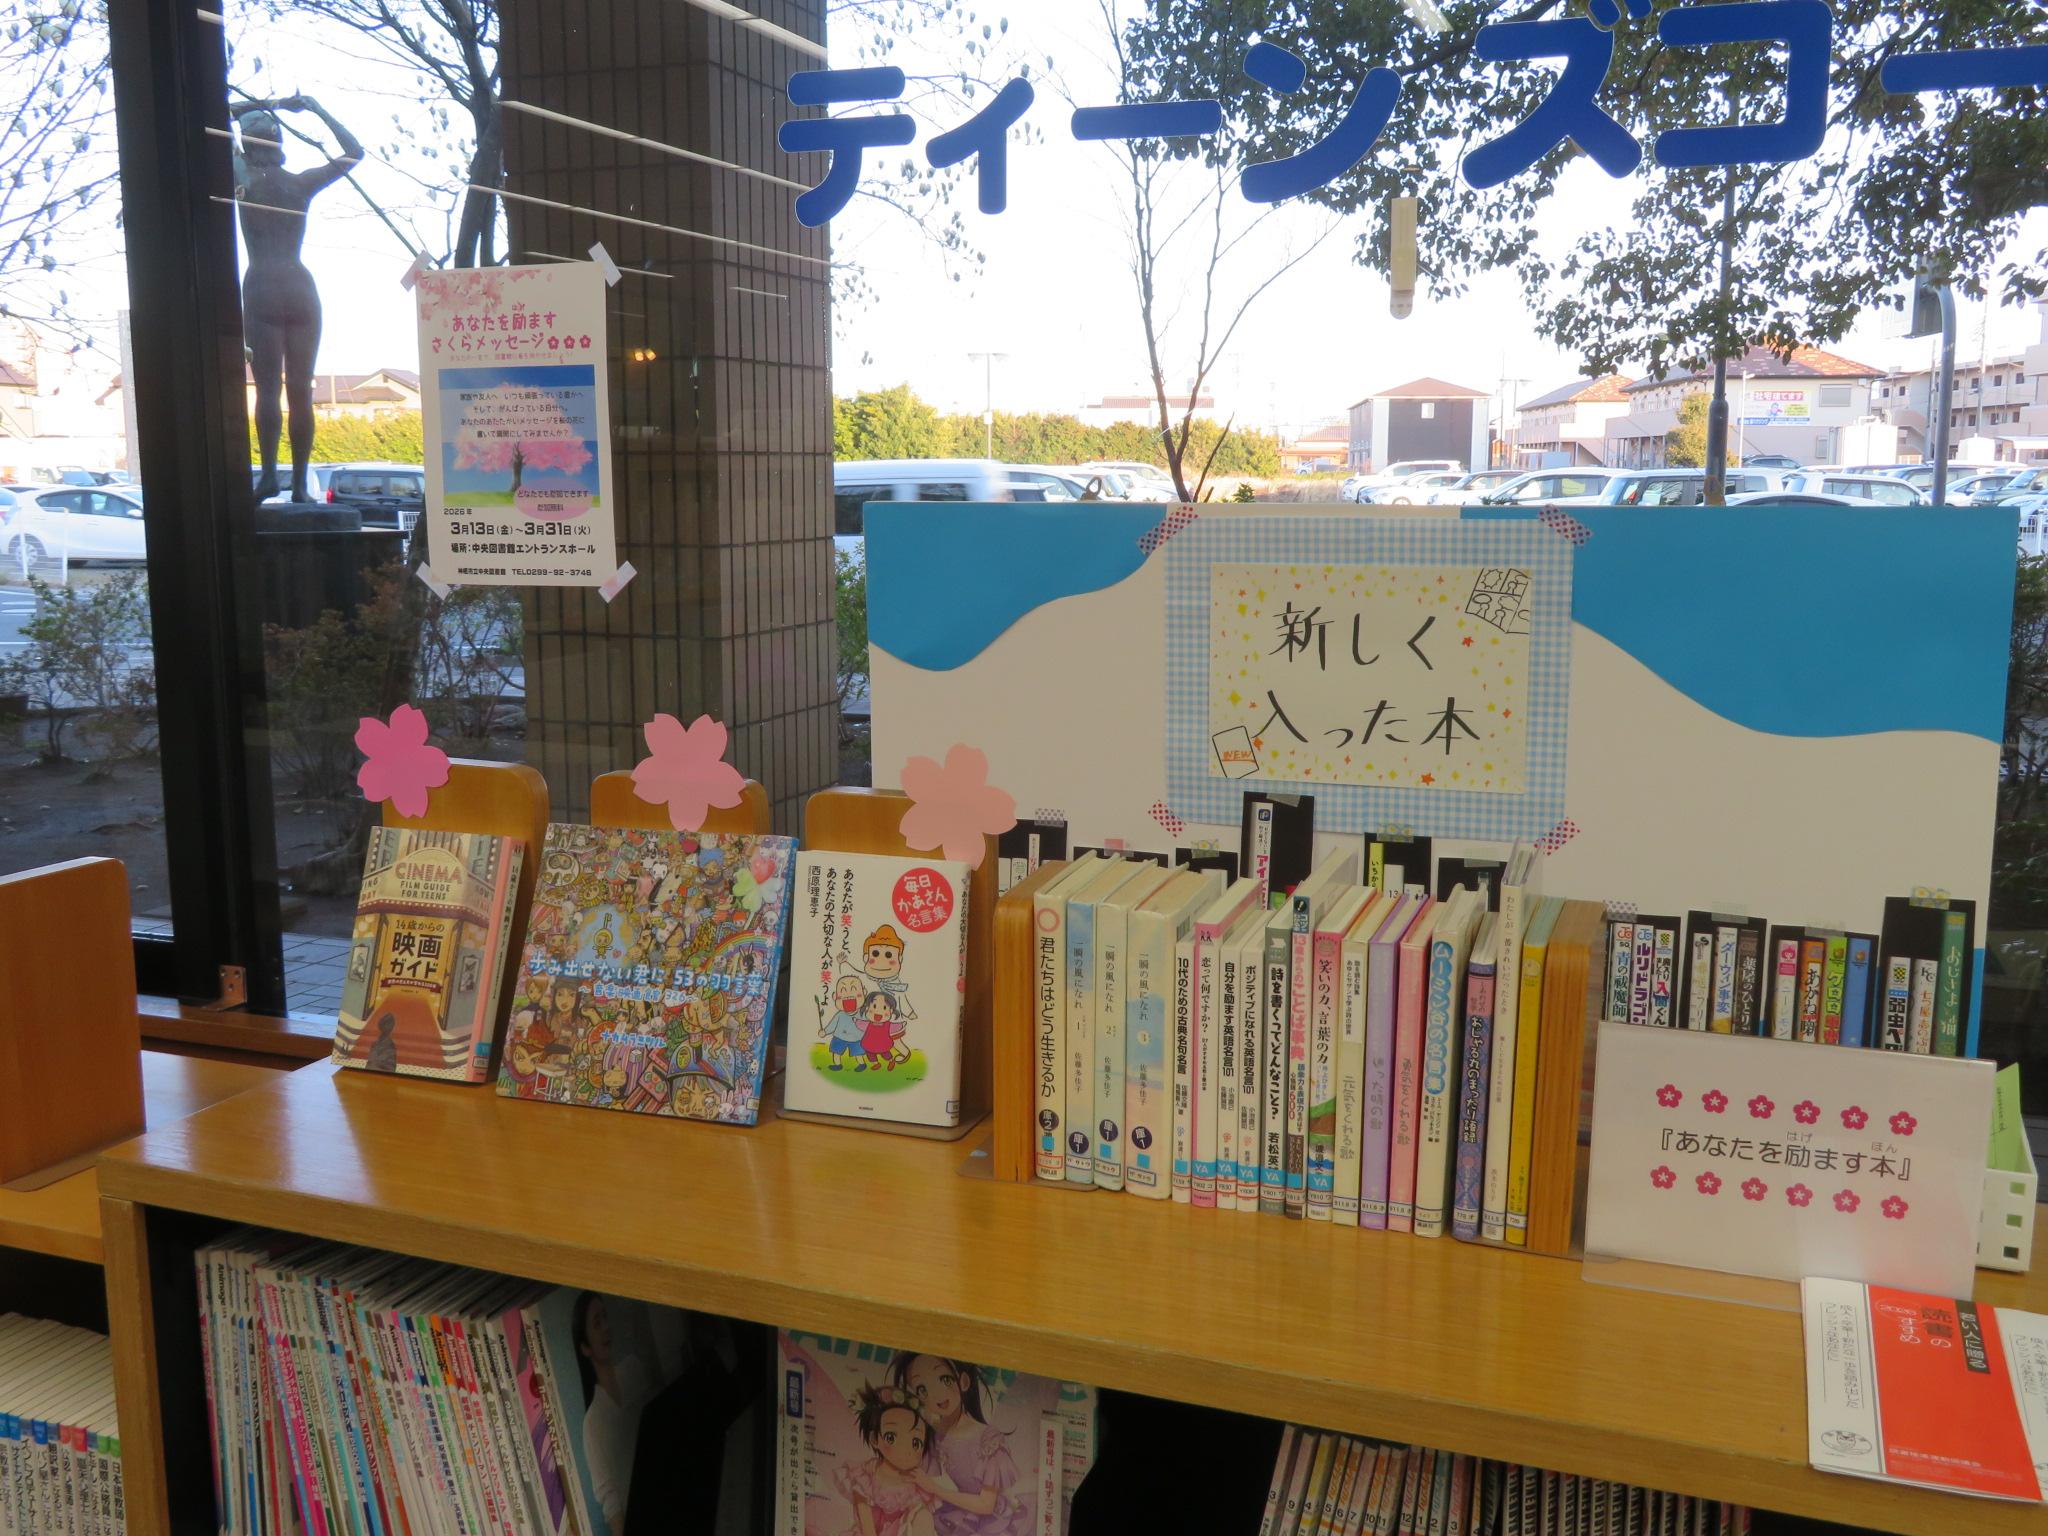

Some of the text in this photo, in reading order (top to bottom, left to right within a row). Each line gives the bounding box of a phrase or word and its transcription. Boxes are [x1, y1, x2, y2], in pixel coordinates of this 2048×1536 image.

[451, 311, 557, 332] あなたを励ます
[431, 333, 545, 353] さくらメッセージ
[1268, 601, 1437, 671] 新しく
[1251, 690, 1481, 756] 入った本
[395, 862, 464, 885] CINEMA
[400, 880, 451, 892] FILM GUIDE
[810, 865, 821, 918] 西原理恵子
[904, 874, 931, 893] 毎日
[401, 889, 447, 900] FOR TEENS
[840, 866, 854, 955] あなたが笑うと、
[897, 886, 948, 913] かあさん
[395, 919, 445, 932] 14歳からの
[820, 866, 837, 1007] あなたの大切な人が笑うよ
[908, 906, 948, 928] 名言集
[391, 931, 442, 960] 映画
[390, 957, 439, 979] ガイド
[528, 951, 666, 986] 歩み出せない君に
[1073, 941, 1084, 1010] 一瞬の風になれ
[1104, 944, 1115, 1014] 一瞬の風になれ
[1138, 952, 1149, 1021] 一瞬の風になれ
[1632, 943, 1651, 1025] ルリドラゴ
[1715, 942, 1735, 1014] ダーウィン事変
[1315, 958, 1332, 1065] 笑いの力、言葉の力
[1737, 955, 1756, 1033] 薬屋のひとり
[1038, 935, 1057, 1099] 君たちはどう生きるか
[1176, 957, 1190, 1075] 10代のための古典名句名言
[1222, 961, 1235, 1077] 自分を励ます英語名言101
[1242, 965, 1256, 1095] ポジティブになれる英語名言101
[1194, 1163, 1209, 1174] YA
[1218, 1162, 1232, 1173] YA
[1267, 1131, 1280, 1170] 若松英
[1661, 1127, 1912, 1182] 『あなたを励ます本』
[1240, 1168, 1254, 1178] YA
[1265, 1170, 1280, 1181] YA
[1314, 1176, 1328, 1187] YA
